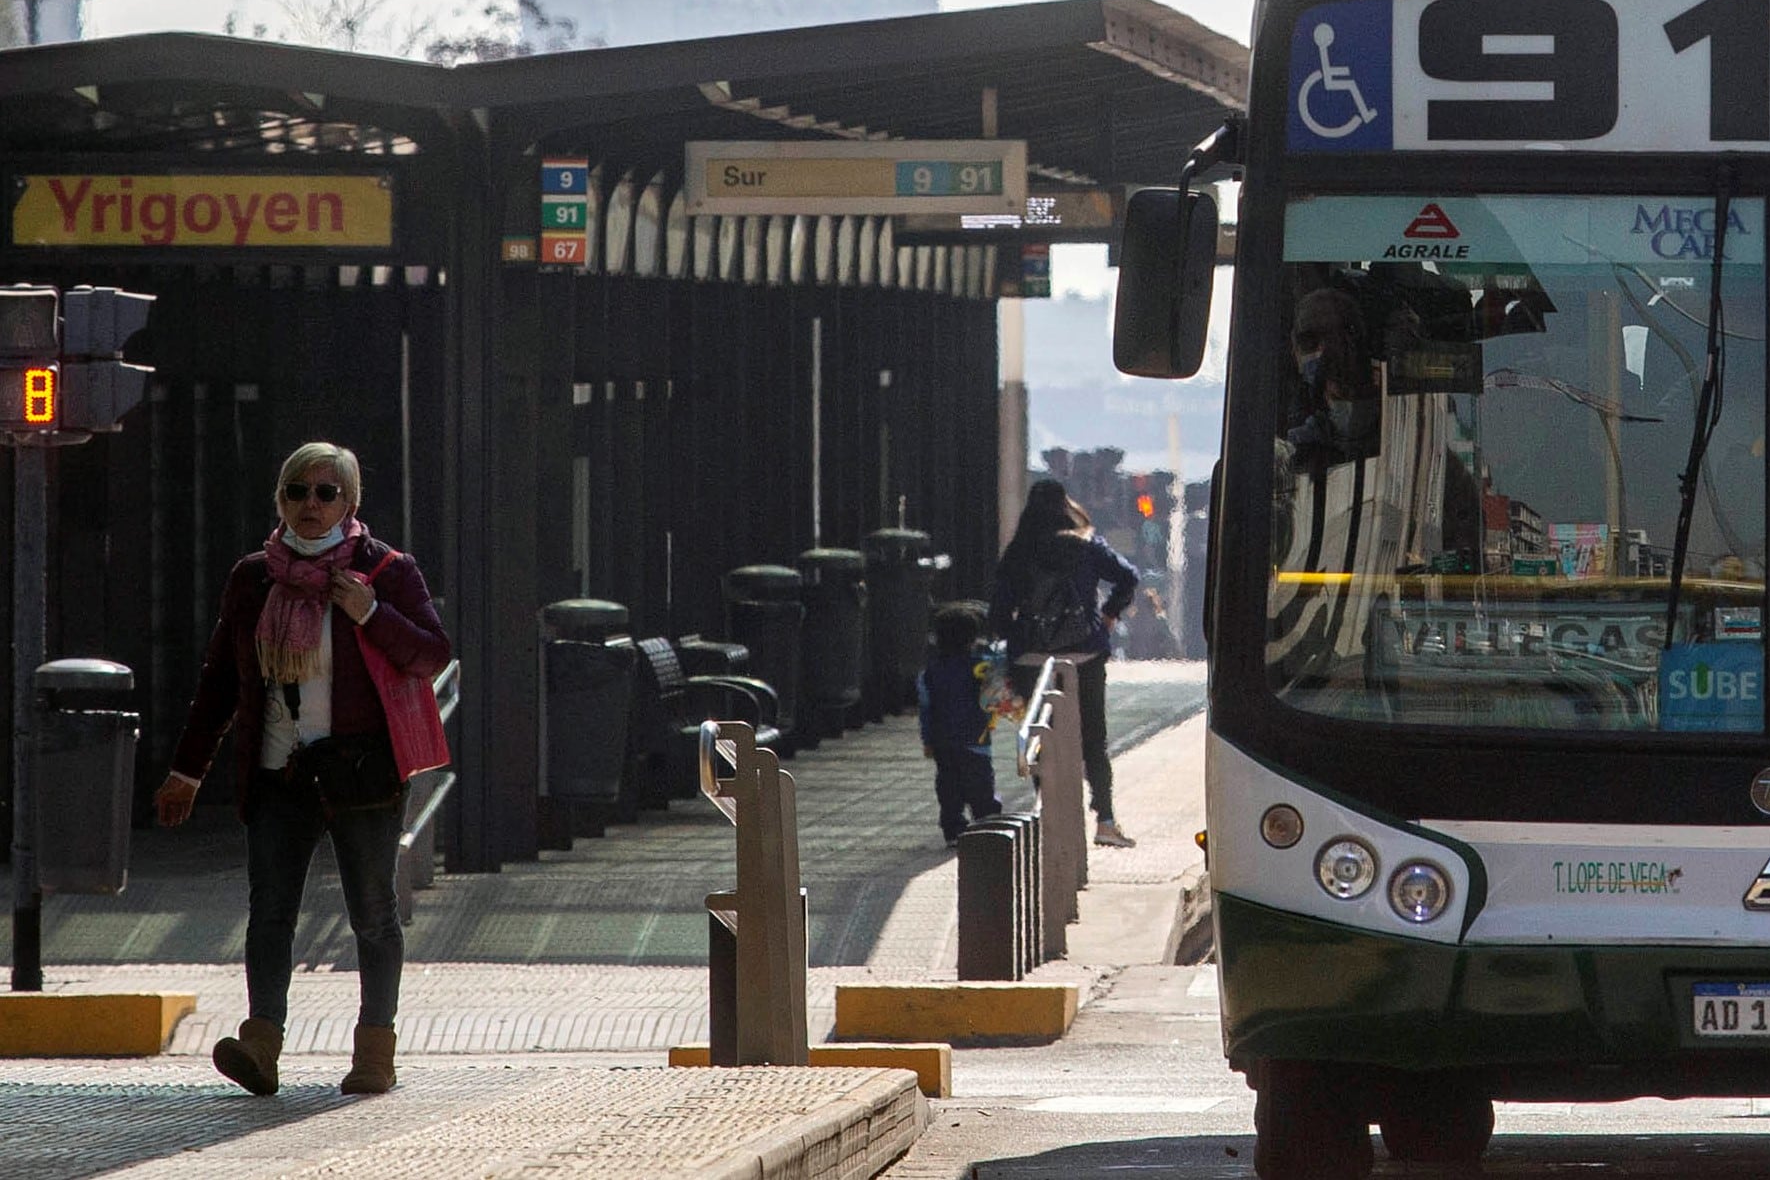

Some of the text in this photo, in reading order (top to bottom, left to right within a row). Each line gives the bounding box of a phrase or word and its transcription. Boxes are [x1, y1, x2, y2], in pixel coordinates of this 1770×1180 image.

[561, 171, 573, 188] 9
[723, 166, 767, 187] Sur
[913, 167, 993, 193] 9 91
[48, 178, 344, 245] Yrigoyen
[556, 206, 578, 223] 91
[1631, 204, 1750, 235] MEGA
[554, 242, 578, 259] 67
[1384, 245, 1470, 259] AGRALE
[1651, 233, 1732, 260] CAR
[24, 368, 54, 423] 8
[1668, 662, 1758, 701] SUBE
[1553, 862, 1668, 893] T. LOPE DE VEGA
[1701, 1000, 1739, 1030] AD
